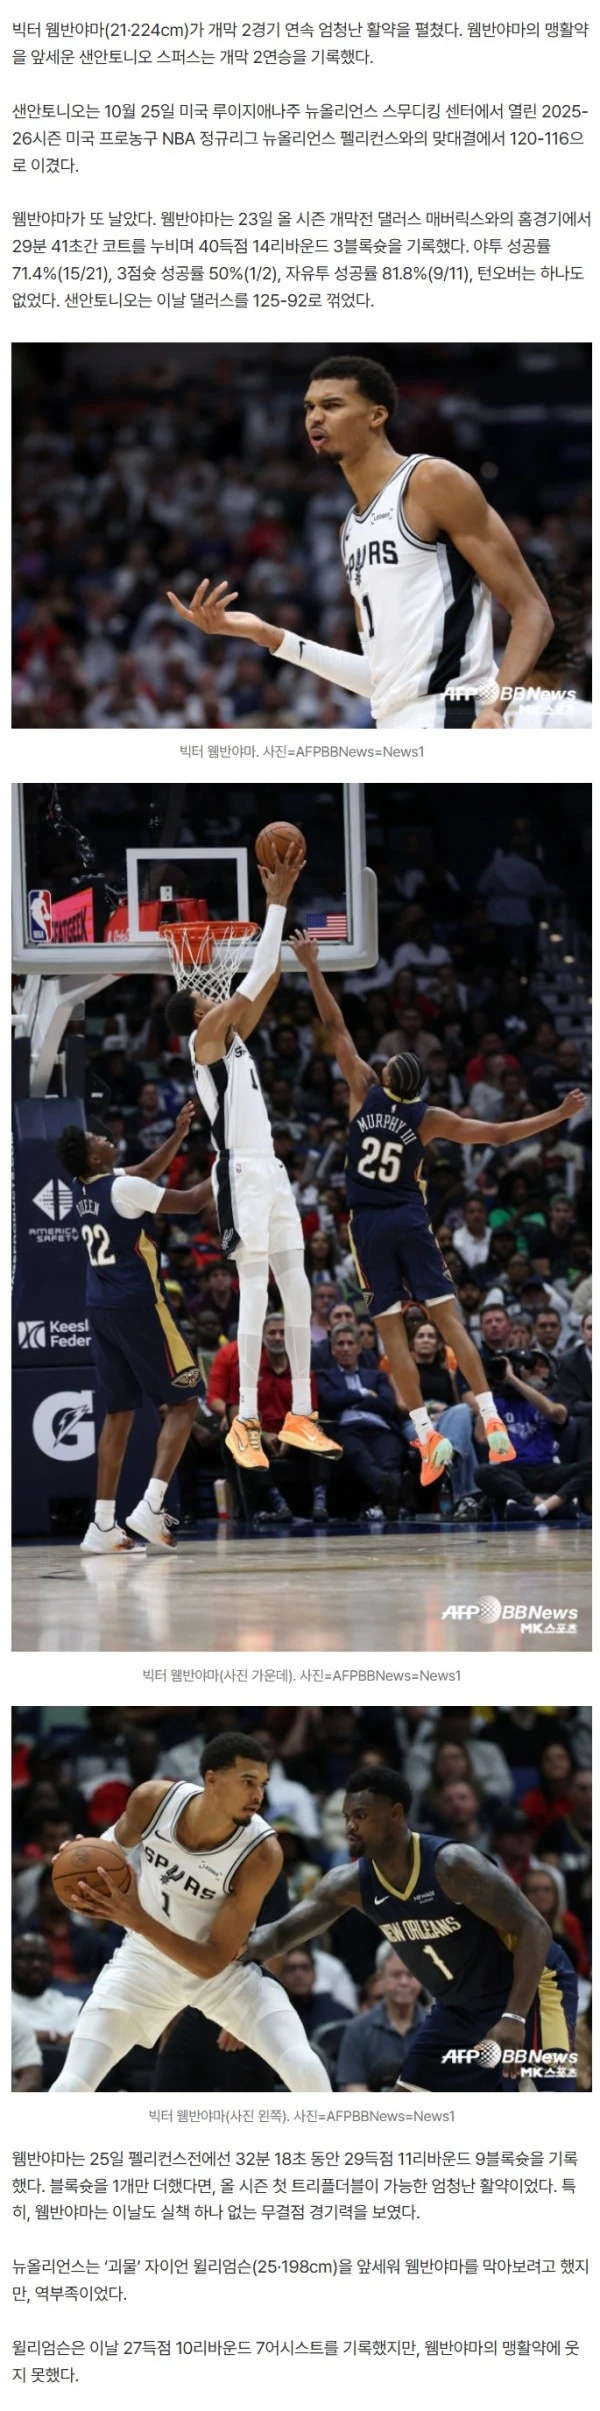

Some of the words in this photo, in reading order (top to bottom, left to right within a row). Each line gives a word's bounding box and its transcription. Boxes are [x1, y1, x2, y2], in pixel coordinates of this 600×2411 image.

[12, 21, 41, 38] 빅터
[208, 21, 238, 39] 개막
[241, 21, 280, 38] 2경기
[284, 21, 315, 39] 연속
[318, 21, 363, 39] 엄청난
[366, 21, 411, 38] 활약을
[414, 21, 463, 38] 펼쳤다.
[467, 21, 540, 39] 웸반야마의
[544, 21, 590, 39] 맹활약
[30, 48, 76, 65] 앞세운
[79, 48, 153, 66] 샌안토니오
[156, 48, 216, 66] 스퍼스는
[219, 48, 250, 66] 개막
[253, 48, 308, 66] 2연승을
[311, 48, 374, 66] 기록했다.
[12, 103, 101, 120] 샌안토니오는
[104, 102, 136, 120] 10월
[140, 103, 175, 120] 25일
[179, 102, 209, 120] 미국
[212, 102, 301, 120] 루이지애나주
[304, 103, 379, 120] 뉴올리언스
[382, 103, 440, 120] 스무디킹
[445, 102, 504, 120] 센터에서
[541, 104, 589, 119] 2025-
[12, 130, 62, 147] 26시즌
[66, 130, 96, 147] 미국
[99, 130, 159, 147] 프로농구
[162, 131, 196, 146] NBA
[199, 130, 259, 147] 정규리그
[262, 130, 337, 147] 뉴올리언스
[340, 130, 428, 147] 펠리컨스와의
[432, 130, 505, 147] 맞대결에서
[509, 131, 585, 146] 120-116으
[30, 157, 79, 174] 이겼다.
[12, 210, 86, 228] 웸반야마가
[108, 210, 157, 228] 날았다.
[160, 210, 235, 228] 웸반야마는
[238, 210, 273, 227] 23일
[295, 210, 326, 228] 시즌
[329, 210, 373, 228] 개막전
[377, 210, 422, 228] 댈러스
[425, 210, 514, 228] 매버릭스와의
[517, 210, 591, 228] 홈경기에서
[12, 238, 48, 254] 29분
[51, 238, 99, 254] 41초간
[102, 238, 147, 255] 코트를
[150, 238, 194, 255] 누비며
[198, 237, 248, 255] 40득점
[252, 237, 330, 255] 14리바운드
[333, 238, 403, 255] 3블록슛을
[406, 237, 470, 255] 기록했다.
[506, 237, 552, 255] 성공률
[11, 265, 112, 284] 71.4%(15/21),
[117, 264, 157, 282] 3점슛
[160, 265, 205, 282] 성공률
[209, 265, 281, 284] 50%(1/2),
[285, 264, 331, 282] 자유투
[333, 265, 378, 282] 성공률
[382, 265, 473, 284] 81.8%(9/11),
[477, 265, 537, 282] 턴오버는
[539, 265, 585, 282] 하나도
[12, 292, 60, 309] 없었다.
[64, 292, 153, 309] 샌안토니오는
[190, 292, 249, 309] 댈러스를
[252, 293, 323, 308] 125-92로
[326, 292, 374, 309] 꺾었다.
[363, 593, 375, 638] 1
[179, 744, 203, 759] 빅터
[207, 744, 259, 759] 웸반야마.
[262, 744, 424, 759] 사진=AFPBBNews=News1
[356, 1113, 407, 1134] MURPHY
[400, 1127, 417, 1146] III
[357, 1136, 403, 1184] 25
[36, 1235, 79, 1243] SAFETY
[81, 1223, 116, 1267] 22
[49, 1317, 90, 1333] Keesl
[50, 1334, 92, 1348] Feder
[32, 1390, 96, 1462] G
[143, 1669, 167, 1682] 빅터
[170, 1668, 248, 1684] 웸반야마(사진
[251, 1668, 296, 1684] 가운데).
[299, 1668, 461, 1683] 사진=AFPBBNews=News1
[144, 1846, 216, 1900] SPURS
[161, 1890, 171, 1918] 1
[402, 1916, 462, 1940] ORLEANS
[422, 1945, 454, 1980] 1
[149, 2109, 173, 2123] 빅터
[176, 2109, 254, 2125] 웸반야마(사진
[258, 2109, 290, 2125] 왼쪽).
[293, 2109, 455, 2123] 사진=AFPBBNews=News1
[11, 2150, 86, 2167] 웸반야마는
[89, 2150, 124, 2167] 25일
[128, 2150, 231, 2168] 펠리컨스전에선
[235, 2151, 271, 2167] 32분
[274, 2151, 307, 2166] 18초
[344, 2150, 393, 2167] 29득점
[397, 2150, 472, 2168] 11리바운드
[475, 2150, 545, 2167] 9블록슛을
[548, 2150, 578, 2167] 기록
[11, 2177, 46, 2195] 했다.
[49, 2178, 109, 2194] 블록슛을
[112, 2177, 150, 2195] 1개만
[153, 2177, 216, 2197] 더했다면,
[239, 2177, 269, 2194] 시즌
[291, 2177, 379, 2195] 트리플더블이
[383, 2177, 428, 2195] 가능한
[431, 2177, 477, 2195] 엄청난
[479, 2177, 557, 2195] 활약이었다.
[12, 2204, 31, 2223] 히,
[34, 2203, 109, 2221] 웸반야마는
[112, 2203, 157, 2221] 이날도
[227, 2203, 258, 2221] 없는
[261, 2203, 305, 2221] 무결점
[309, 2204, 368, 2221] 경기력을
[371, 2204, 420, 2221] 보였다.
[11, 2258, 101, 2275] 뉴올리언스는
[144, 2258, 188, 2275] 자이언
[356, 2258, 400, 2275] 앞세워
[404, 2258, 479, 2275] 웸반야마를
[482, 2258, 557, 2275] 막아보려고
[560, 2258, 589, 2275] 했지
[12, 2285, 31, 2304] 만,
[34, 2285, 127, 2302] 역부족이었다.
[12, 2339, 86, 2356] 윌리엄슨은
[123, 2339, 171, 2356] 27득점
[175, 2339, 252, 2357] 10리바운드
[255, 2339, 339, 2357] 7어시스트를
[343, 2339, 420, 2359] 기록했지만,
[424, 2339, 497, 2357] 웸반야마의
[502, 2339, 561, 2357] 맹활약에
[30, 2366, 79, 2384] 못했다.
